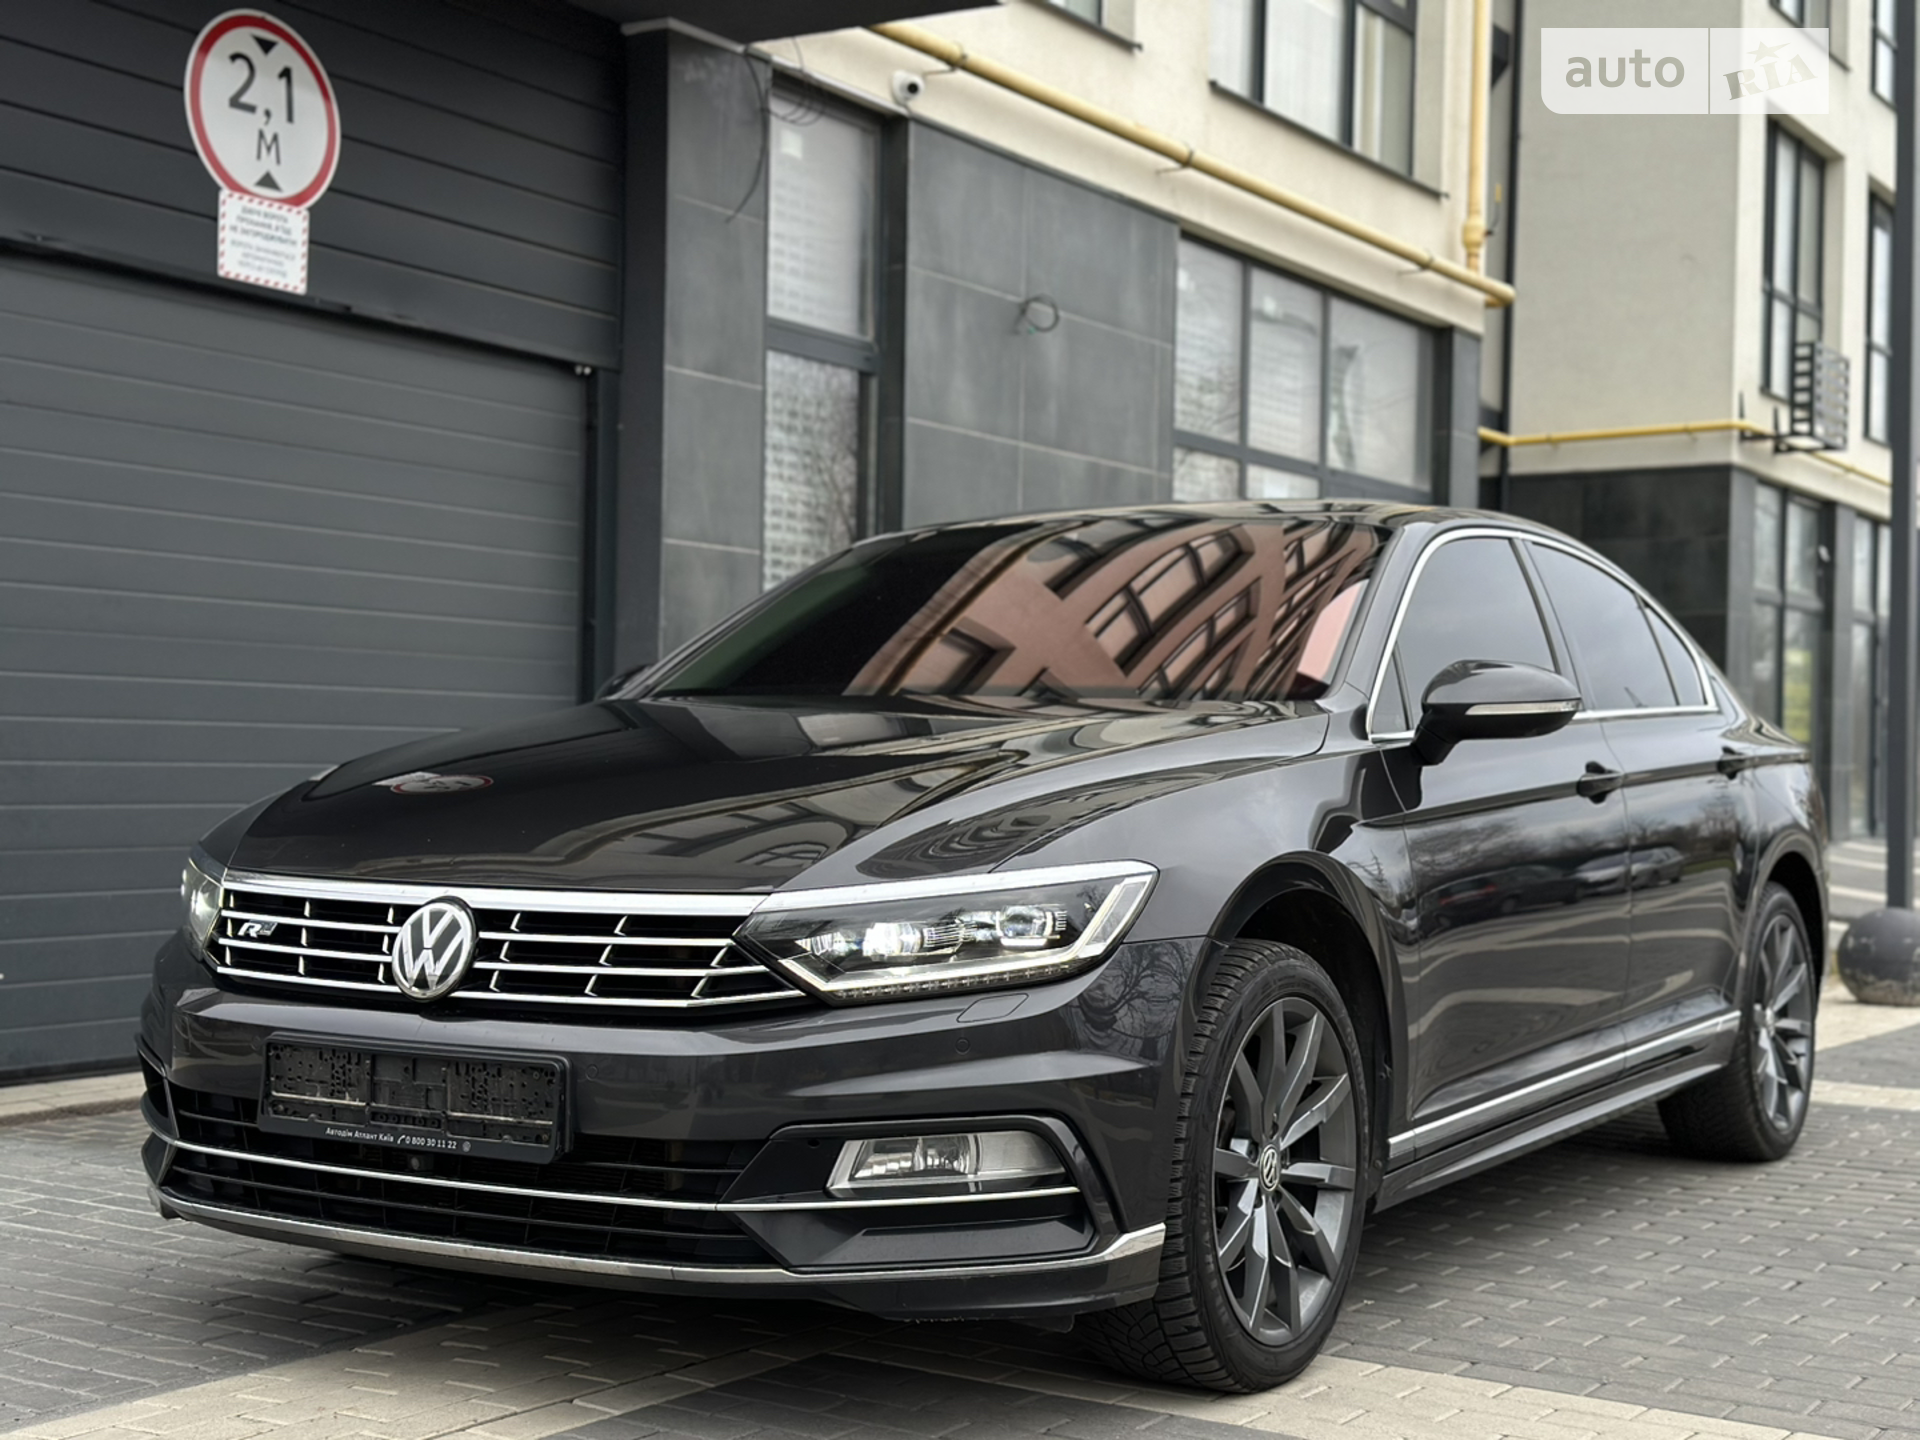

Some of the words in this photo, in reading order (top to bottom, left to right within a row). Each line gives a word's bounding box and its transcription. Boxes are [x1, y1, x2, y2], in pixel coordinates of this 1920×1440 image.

[228, 52, 295, 126] 2,1
[394, 902, 473, 998] VW
[325, 1127, 353, 1138] Автодім
[354, 1131, 377, 1141] Атлант
[378, 1132, 394, 1143] Київ
[405, 1136, 411, 1144] 0
[411, 1137, 426, 1146] 800
[427, 1138, 436, 1147] 30
[437, 1139, 446, 1148] 11
[447, 1140, 457, 1149] 22
